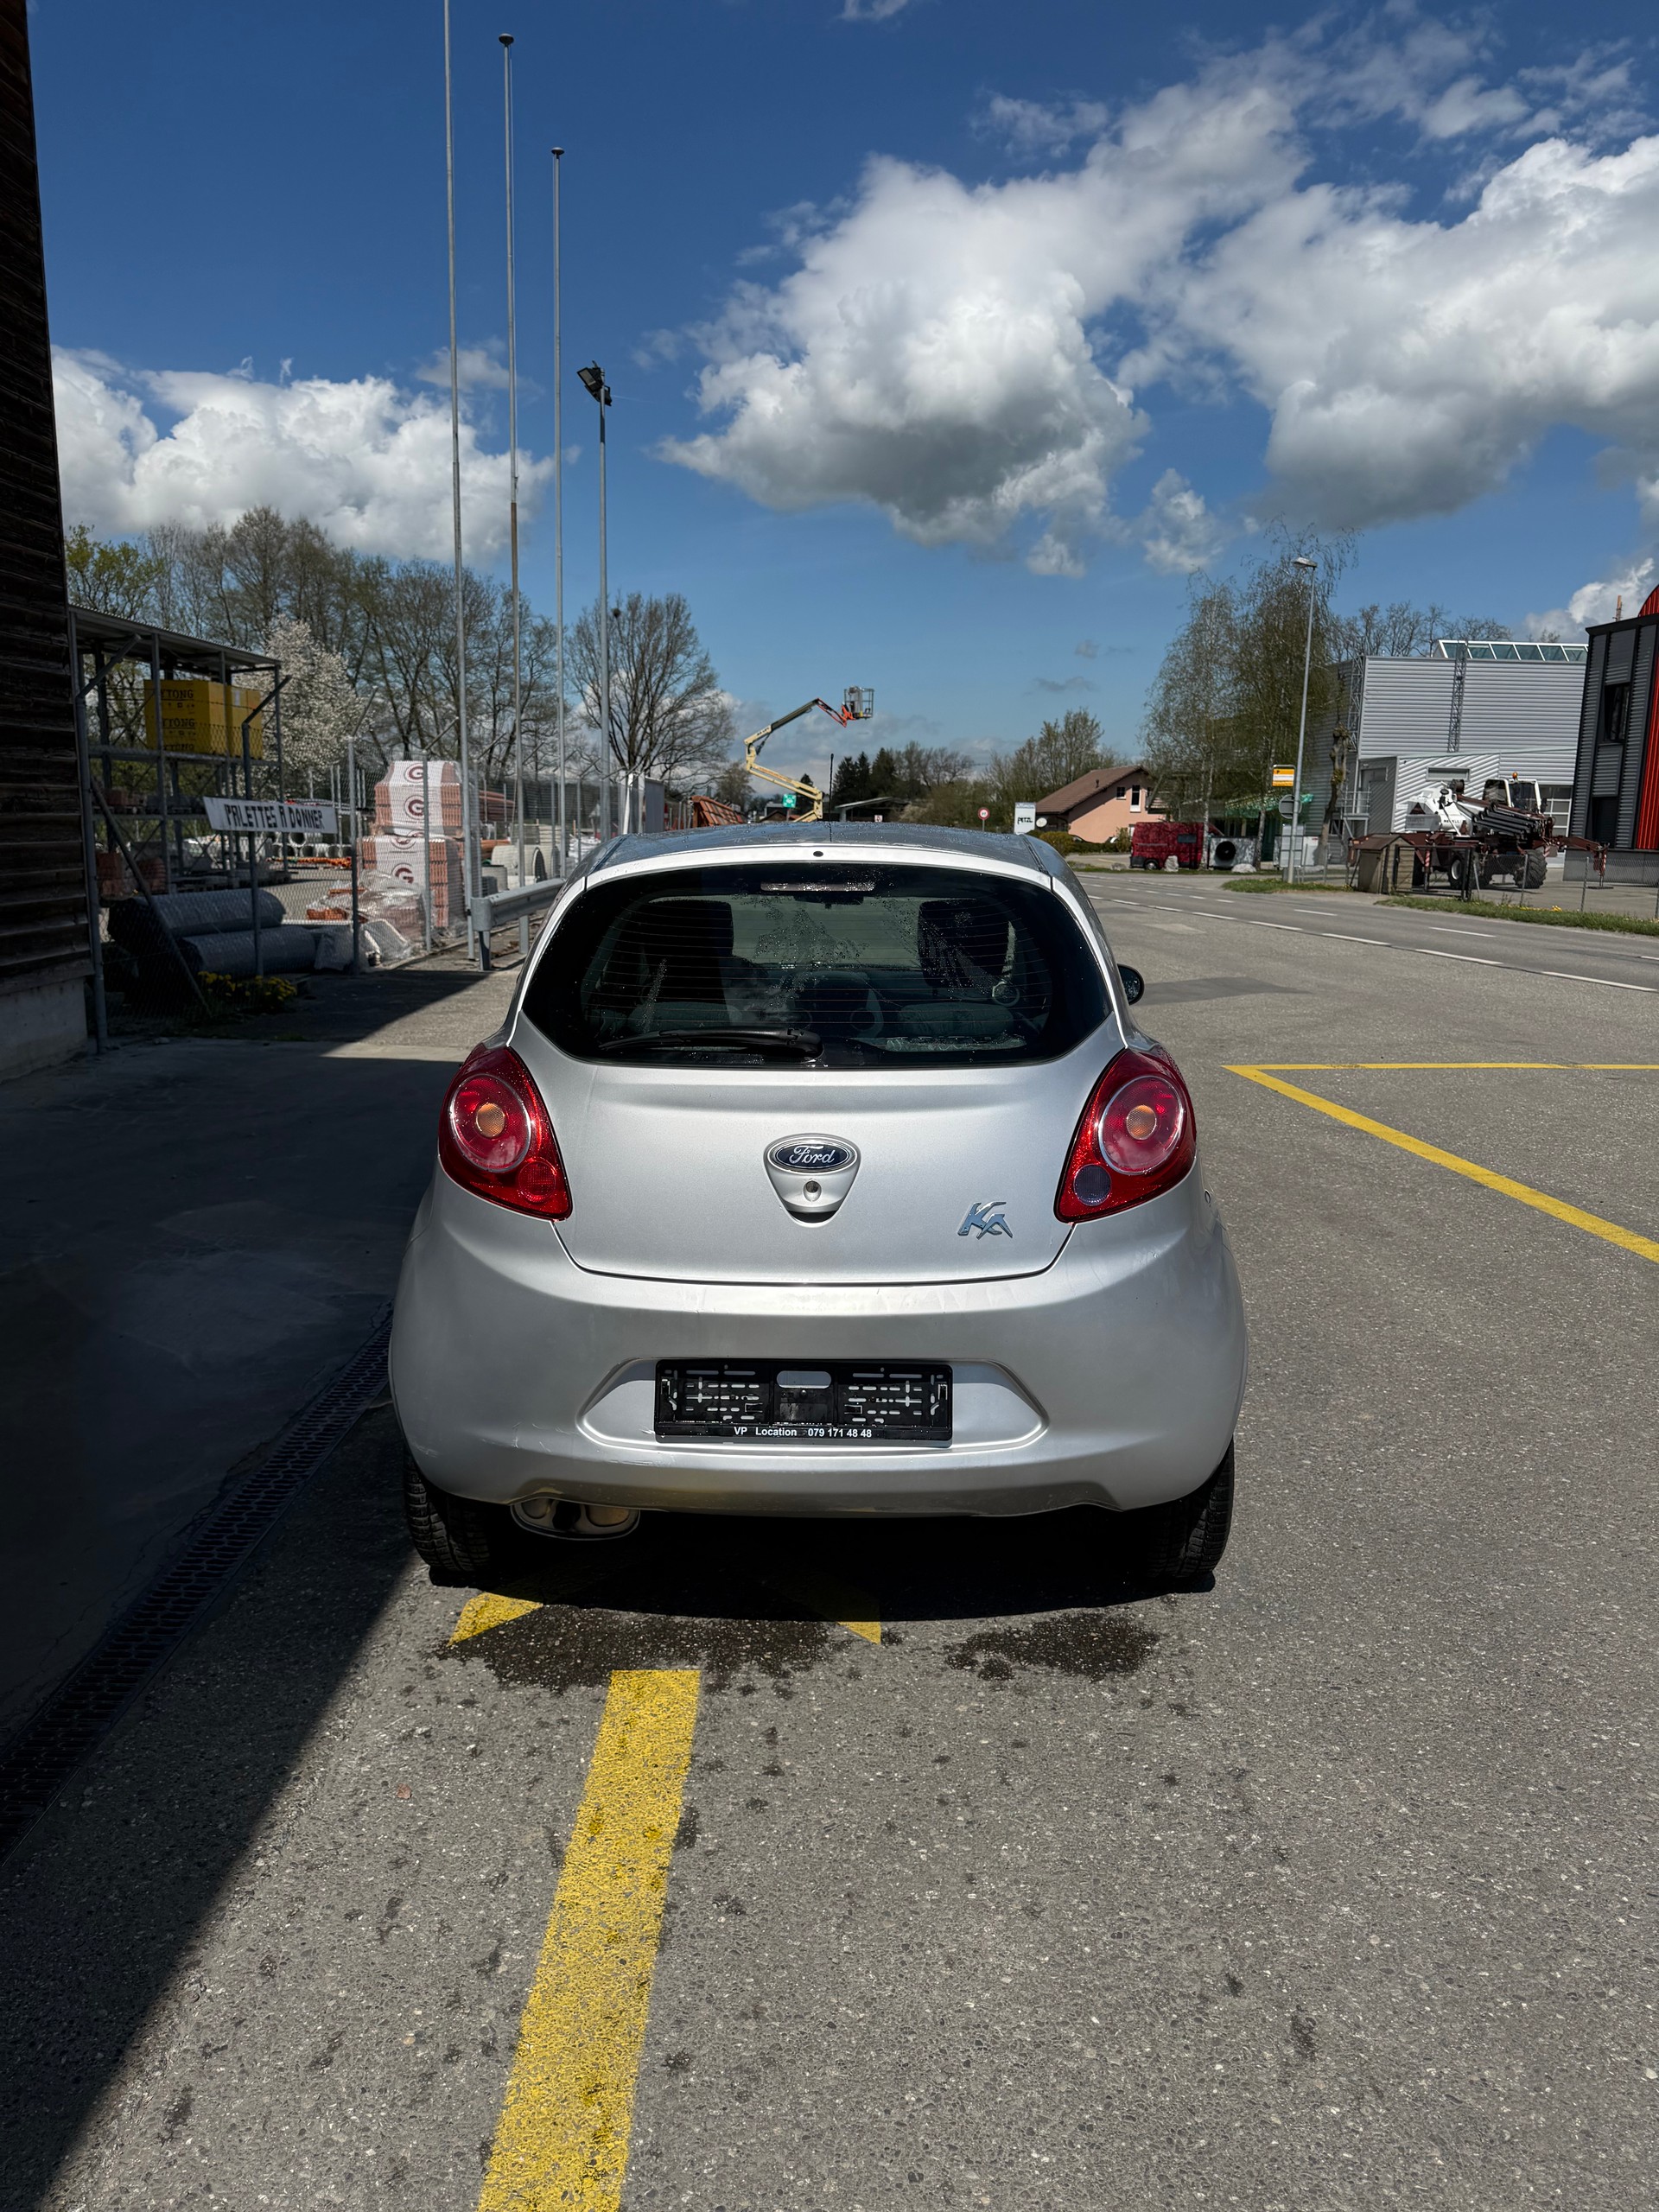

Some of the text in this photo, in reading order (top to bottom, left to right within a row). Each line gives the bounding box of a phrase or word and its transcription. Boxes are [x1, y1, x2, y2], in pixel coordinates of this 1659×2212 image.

[224, 804, 278, 829] PALETTES
[288, 807, 325, 830] DONNER
[789, 1145, 836, 1164] Ford
[734, 1427, 873, 1438] VP Location 079 171 48 48
